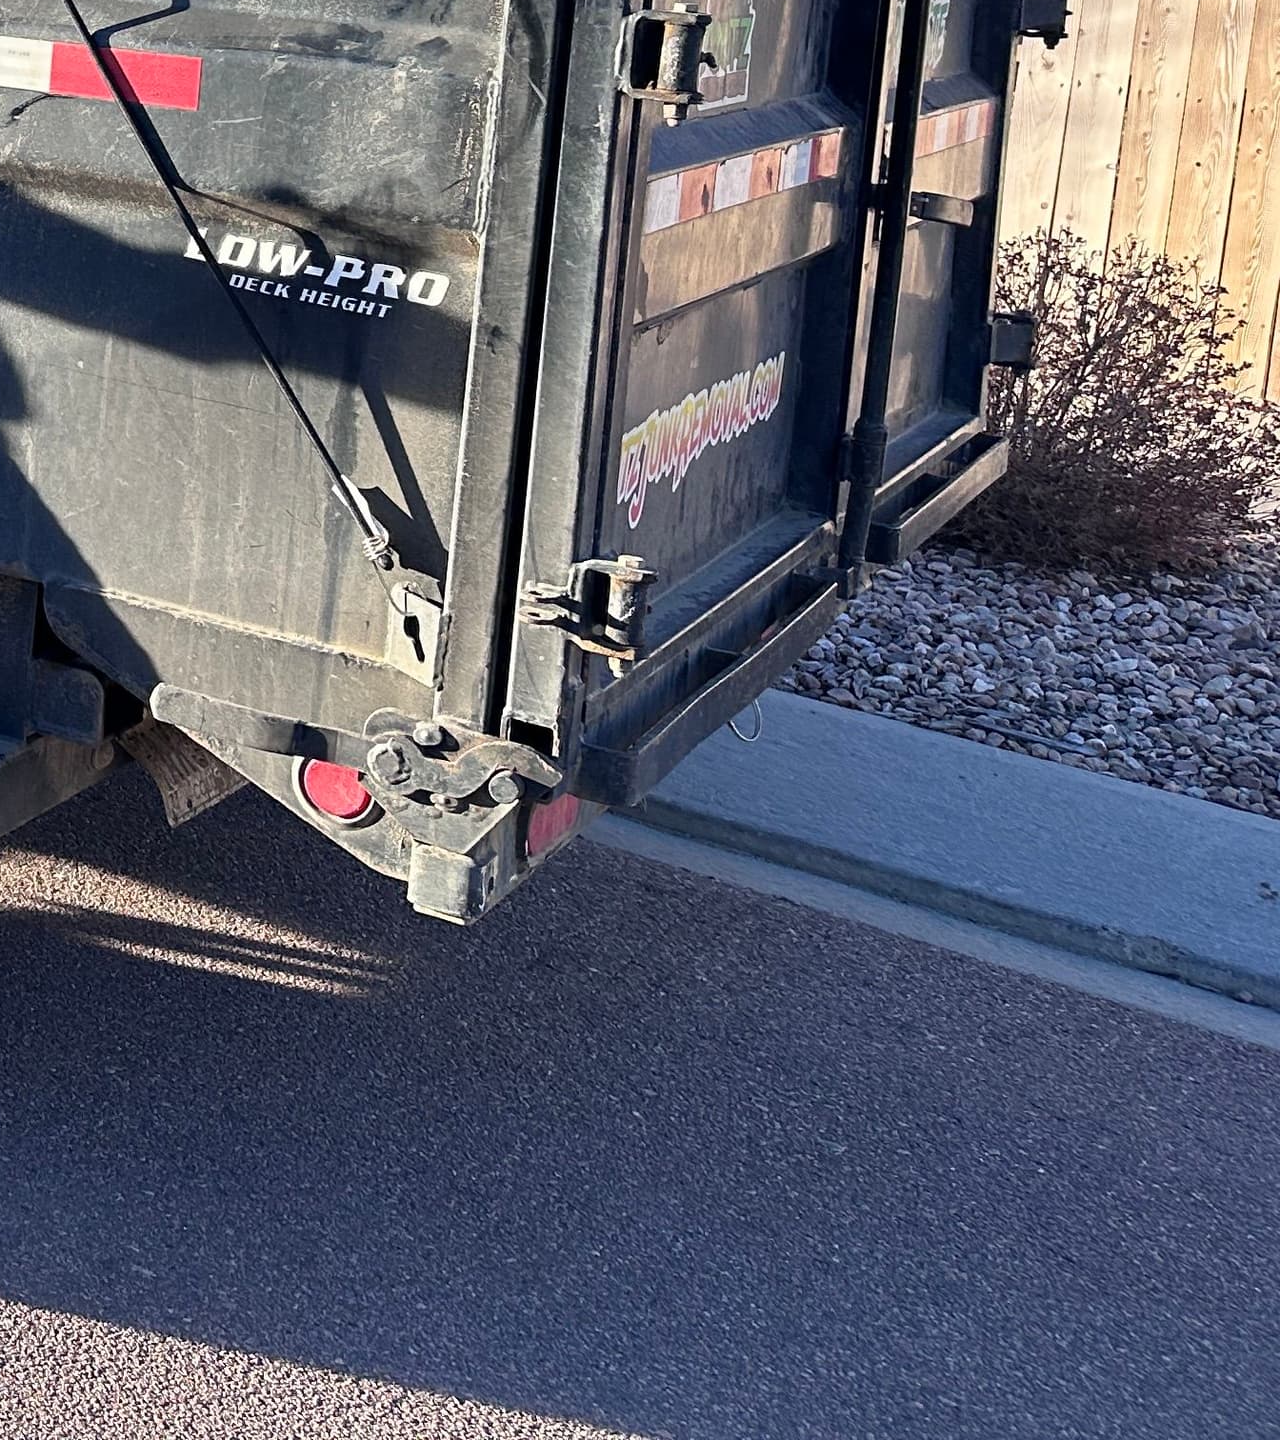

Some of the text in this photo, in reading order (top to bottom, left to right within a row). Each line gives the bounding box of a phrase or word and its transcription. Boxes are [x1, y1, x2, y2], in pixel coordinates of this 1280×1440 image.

[184, 227, 451, 307] LOW-PRO
[228, 273, 393, 319] DECK HEIGHT
